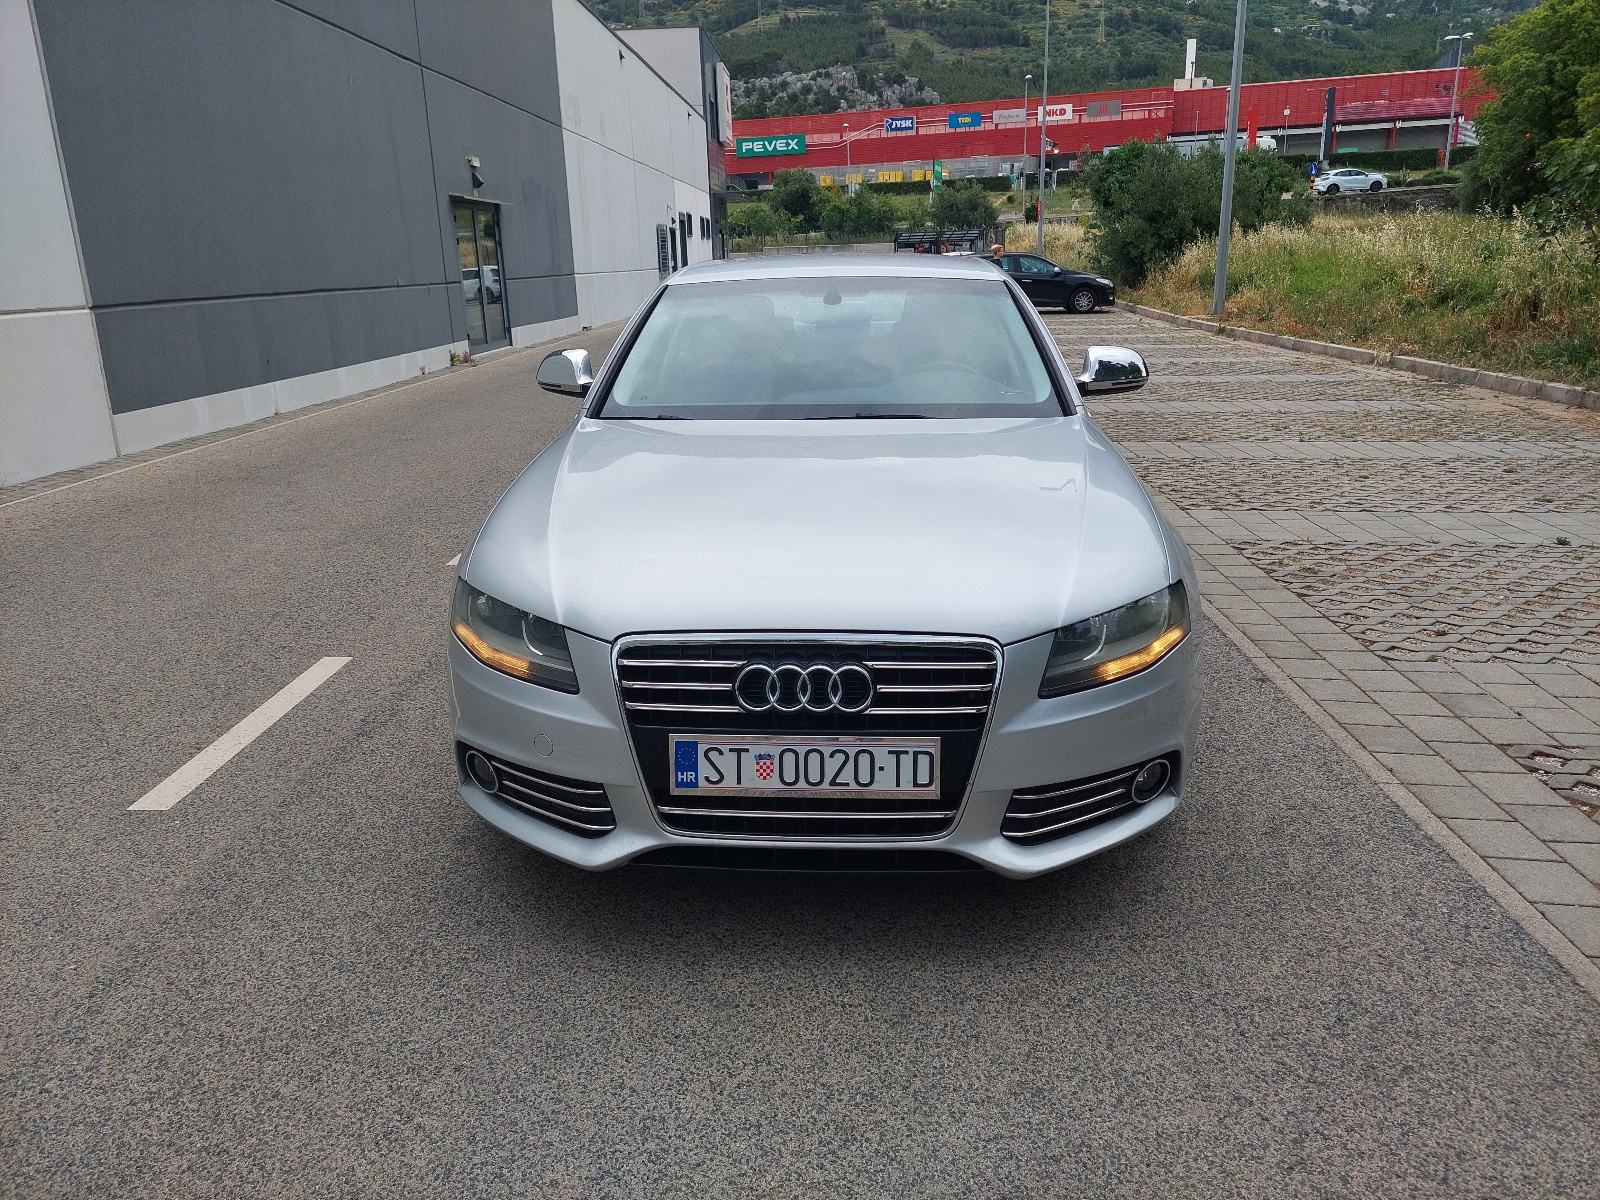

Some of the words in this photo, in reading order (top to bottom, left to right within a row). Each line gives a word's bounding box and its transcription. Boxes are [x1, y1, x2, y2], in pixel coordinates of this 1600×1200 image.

[891, 119, 913, 129] JYSK
[741, 138, 799, 153] PEVEX
[703, 746, 750, 786] ST
[677, 771, 697, 783] HR
